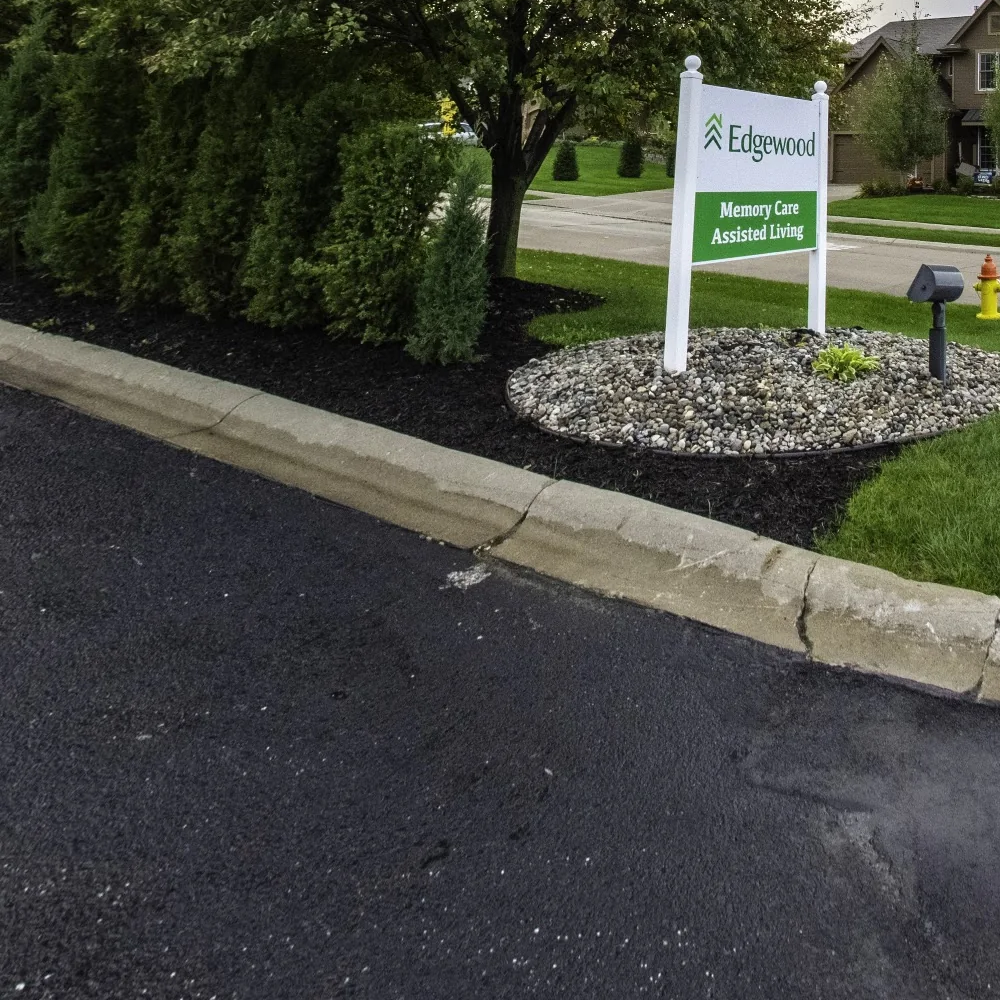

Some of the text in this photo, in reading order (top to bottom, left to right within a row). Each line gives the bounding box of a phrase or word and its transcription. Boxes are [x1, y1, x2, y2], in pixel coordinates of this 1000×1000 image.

[728, 124, 815, 162] Edgewood
[720, 200, 799, 220] Memory Care
[711, 222, 804, 244] Assisted Living
